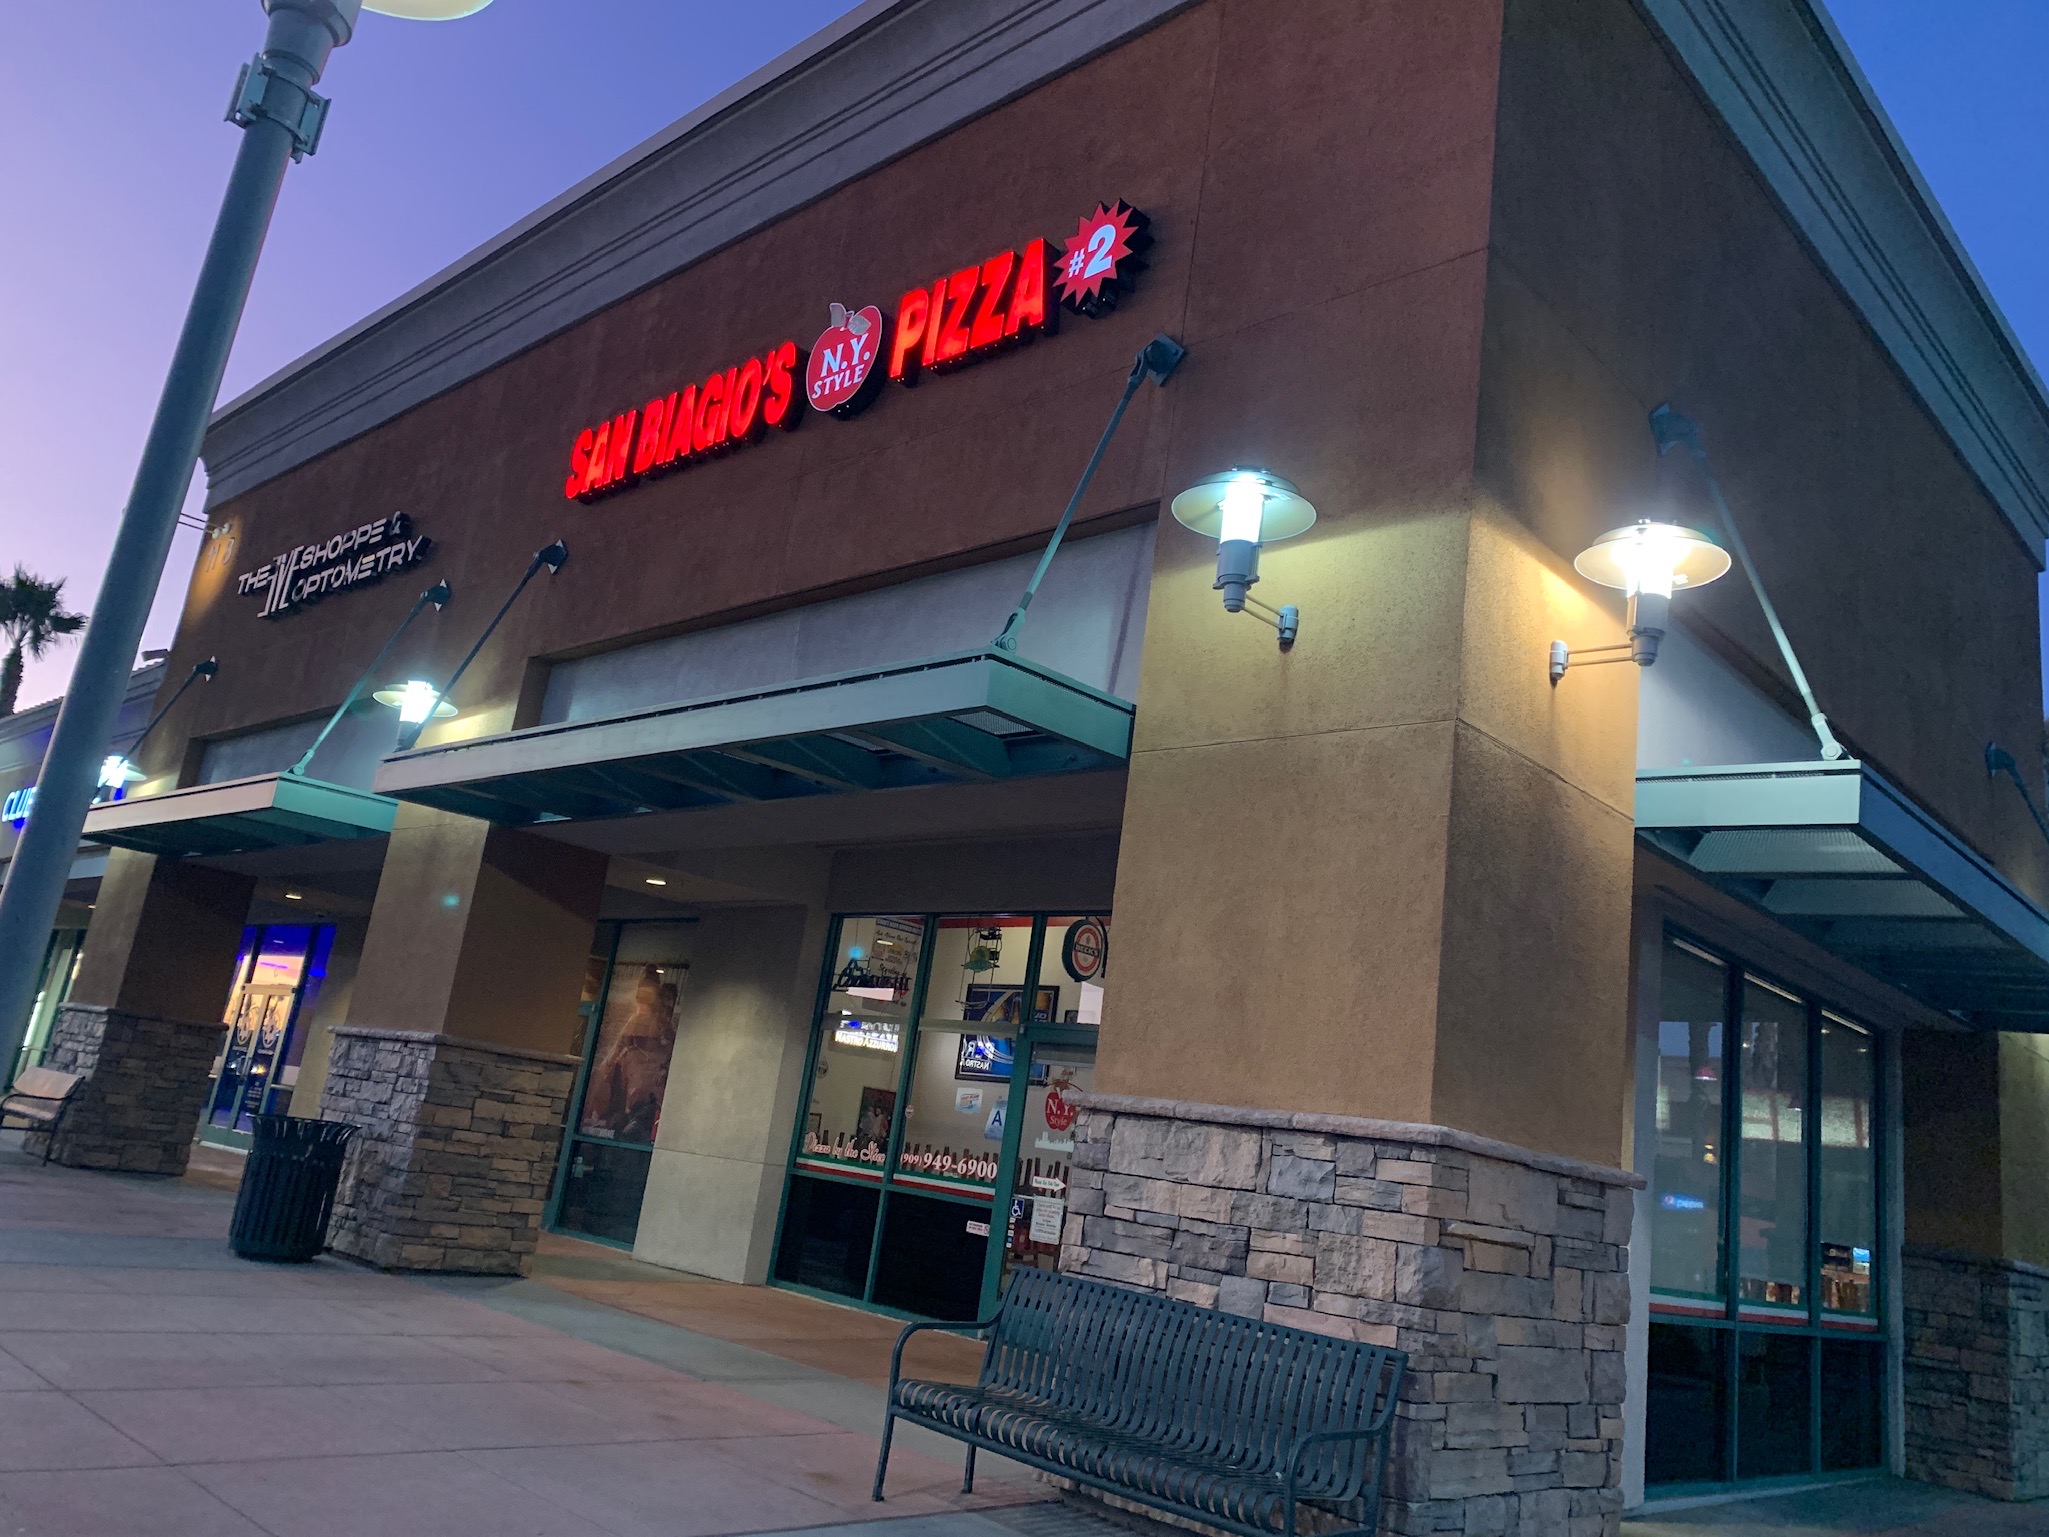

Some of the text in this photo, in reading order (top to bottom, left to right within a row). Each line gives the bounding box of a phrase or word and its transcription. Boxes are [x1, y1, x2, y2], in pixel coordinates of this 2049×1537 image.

[889, 237, 1047, 380] PIZZA
[820, 334, 870, 377] N.Y.
[812, 364, 864, 398] STYLE
[565, 341, 798, 499] SAN BIAGIO'S
[238, 564, 273, 595] THE
[299, 518, 388, 570] SHOPPE
[291, 535, 423, 602] OPTOMETRY
[991, 1110, 1002, 1126] A
[1047, 1099, 1074, 1116] N.Y.
[1050, 1115, 1067, 1126] Style
[804, 1131, 886, 1163] Pizza by the Slice
[900, 1152, 998, 1179] (909) 949-6900
